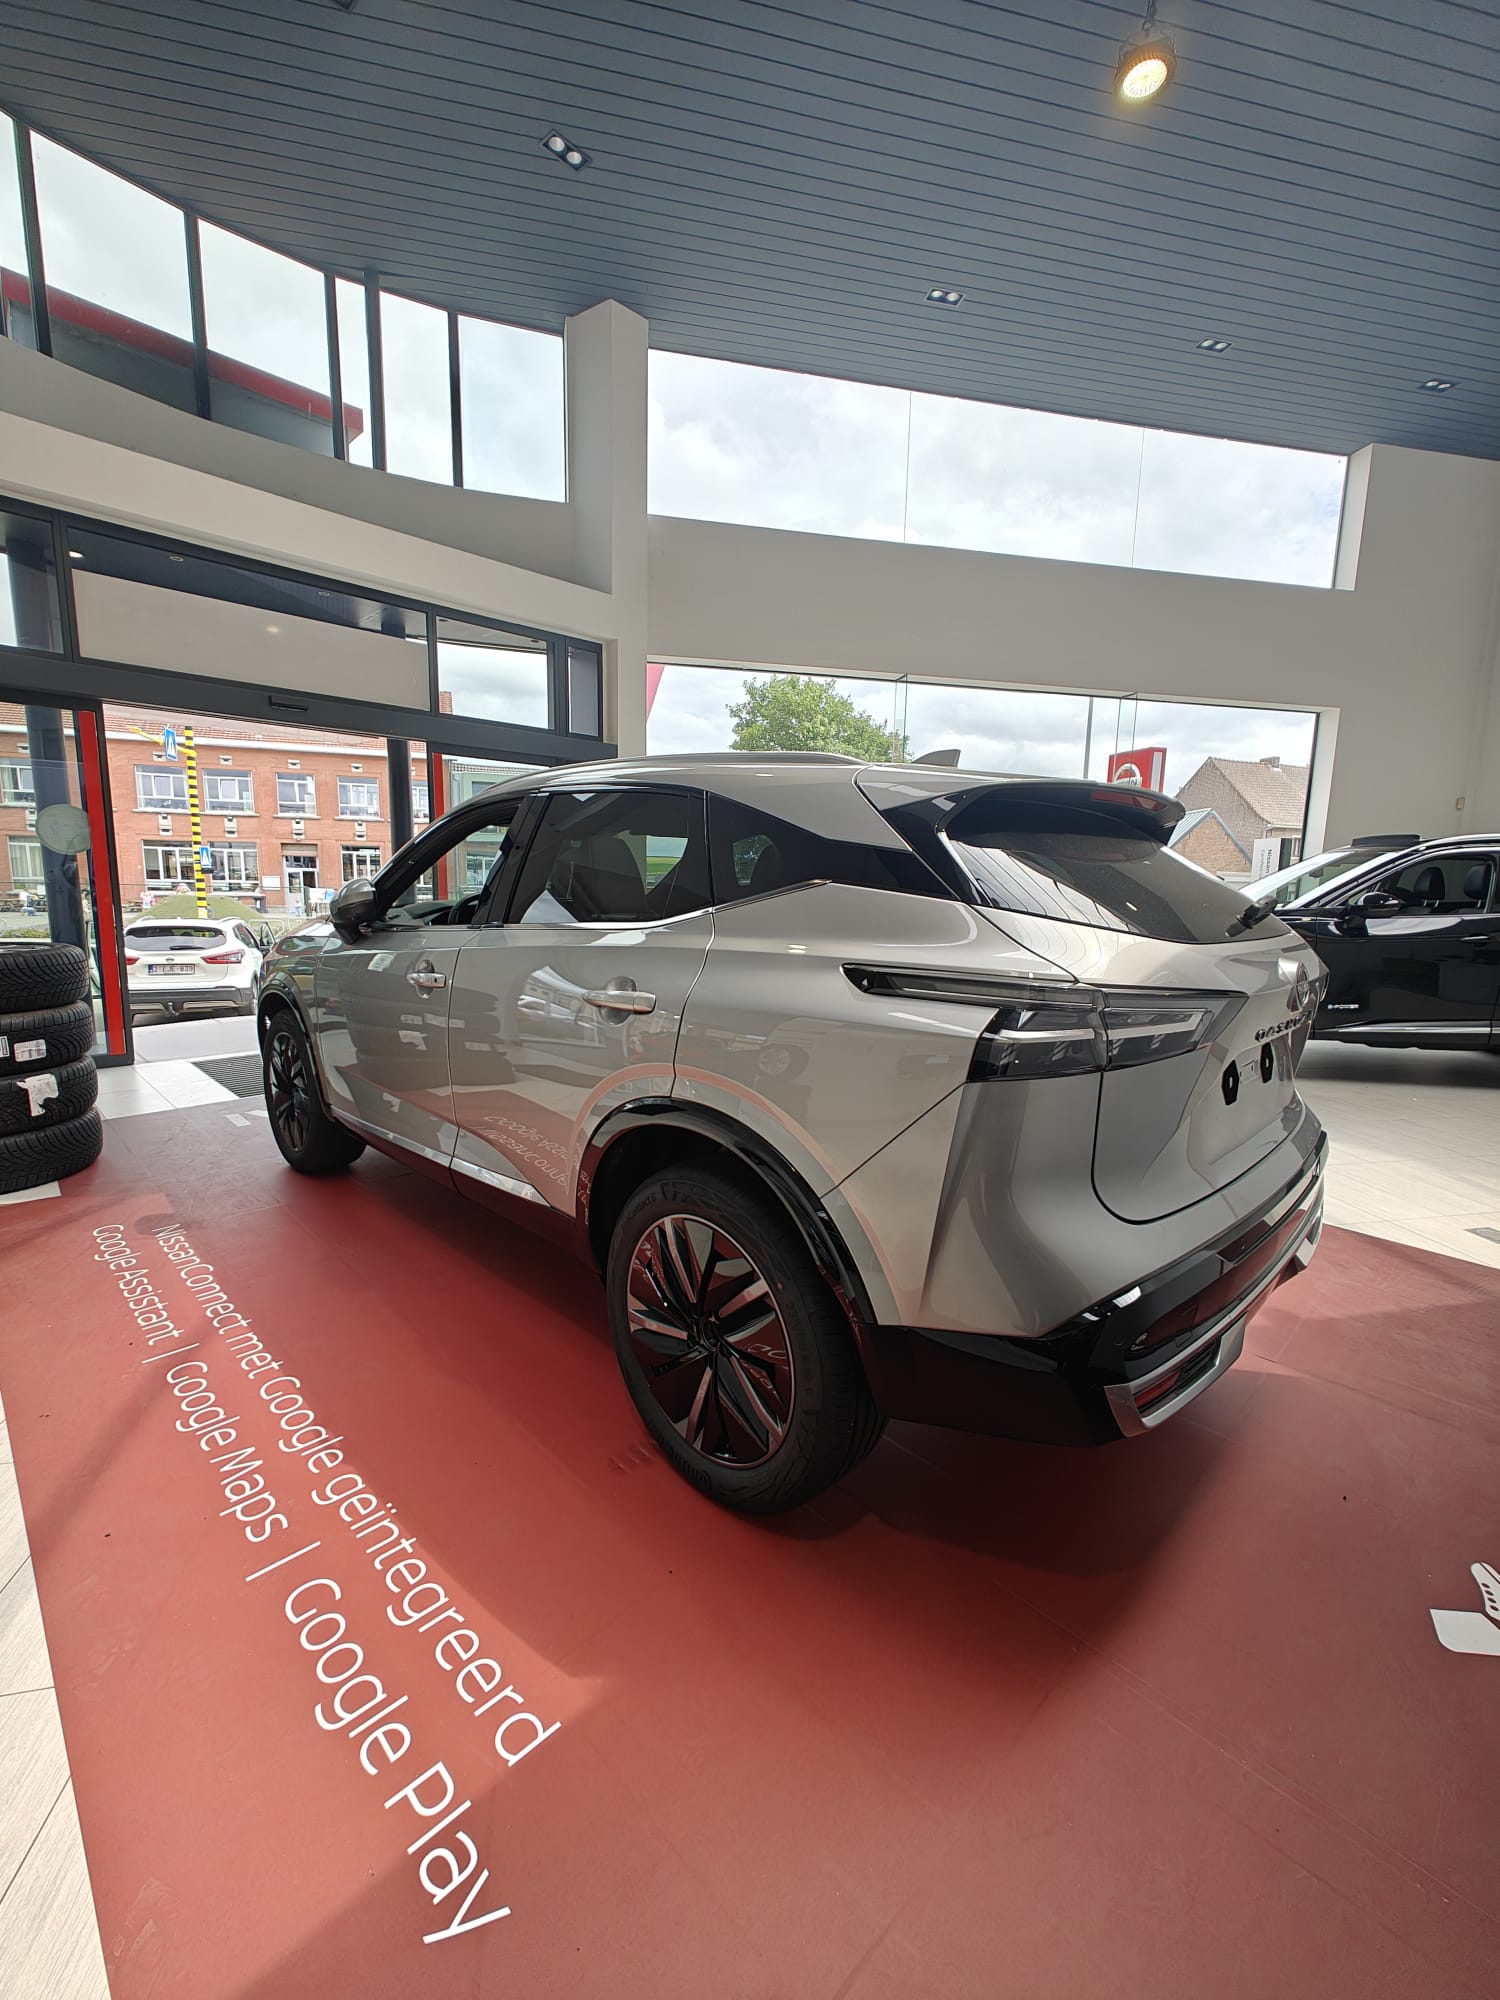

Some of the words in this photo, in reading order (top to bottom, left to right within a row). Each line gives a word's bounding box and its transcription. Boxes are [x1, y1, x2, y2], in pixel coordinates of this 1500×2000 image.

[92, 1224, 143, 1271] Google
[113, 1268, 185, 1346] Assistant
[166, 1361, 237, 1452] Google
[152, 1223, 253, 1335] NissanConnect
[226, 1331, 284, 1380] met
[260, 1376, 345, 1474] Google
[310, 1473, 562, 1768] geïntegreerd
[209, 1446, 289, 1543] Maps
[284, 1578, 412, 1776] Google
[383, 1760, 512, 1945] Play
